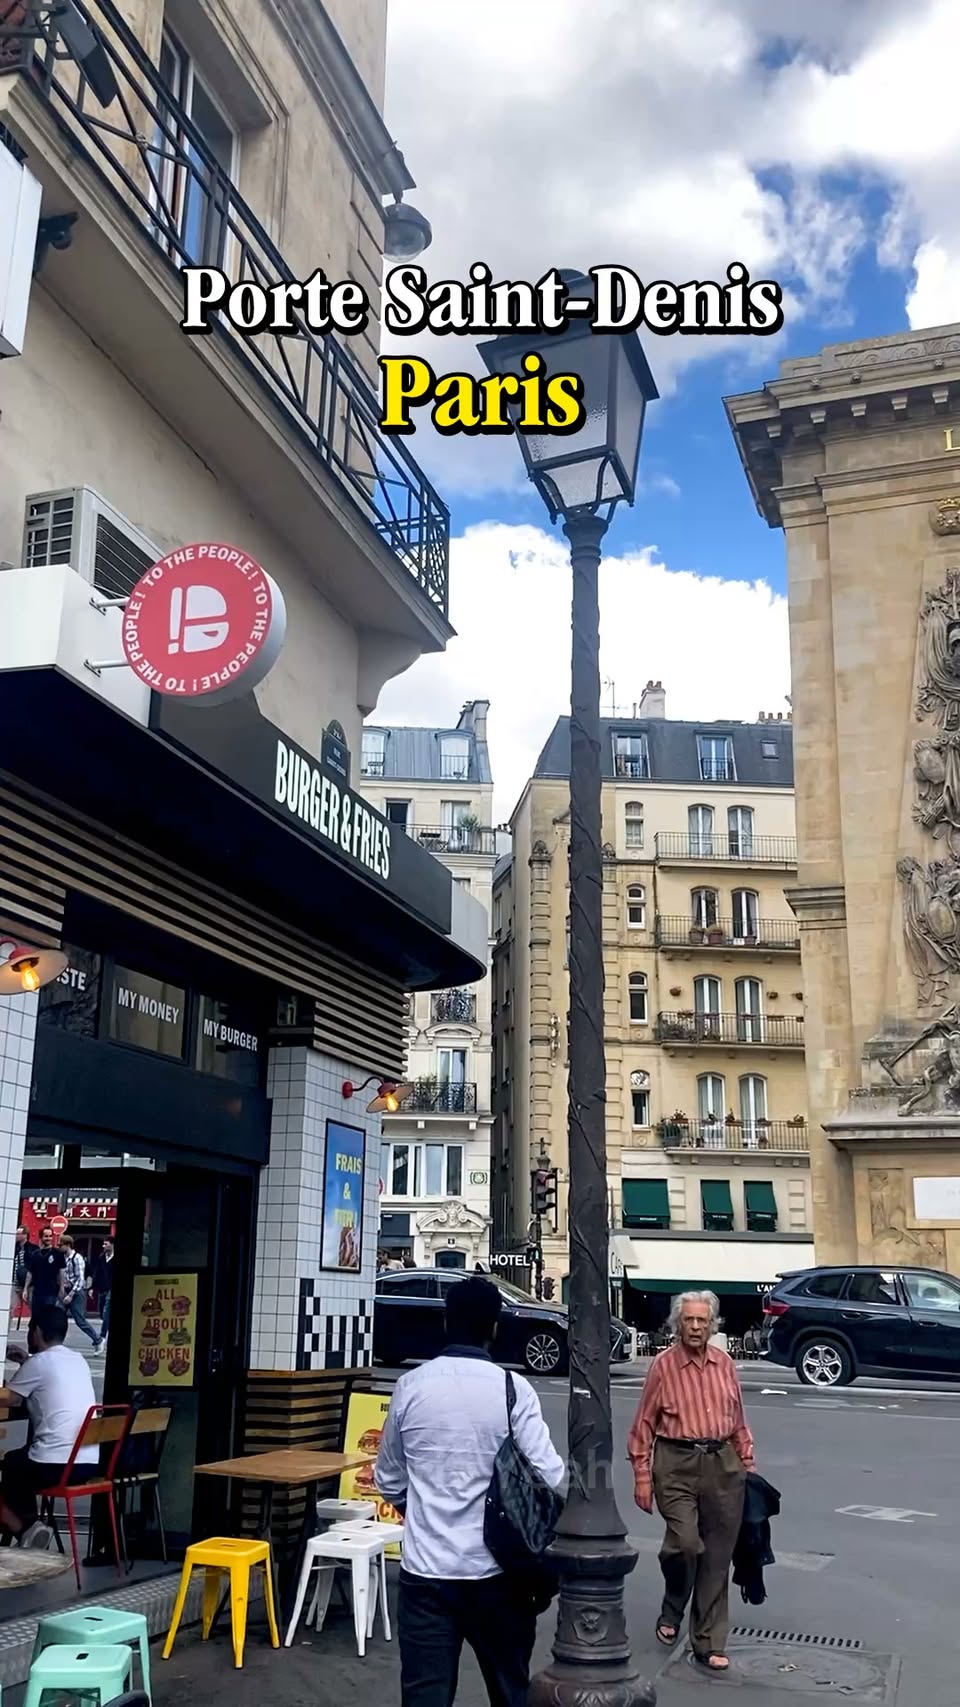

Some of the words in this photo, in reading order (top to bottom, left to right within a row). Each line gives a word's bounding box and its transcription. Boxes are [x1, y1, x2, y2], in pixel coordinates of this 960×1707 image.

[142, 567, 164, 587] TO
[164, 547, 195, 570] THE
[253, 581, 268, 605] TO
[249, 609, 269, 642] THE
[136, 660, 164, 686] THE
[164, 678, 186, 692] TO
[275, 740, 340, 844] BURGER
[340, 794, 351, 853] &
[117, 987, 138, 1009] MY
[138, 994, 180, 1024] MONEY
[203, 1018, 220, 1038] MY
[220, 1024, 258, 1051] BURGER
[335, 1152, 362, 1175] FRAIS
[343, 1182, 351, 1200] &
[489, 1254, 531, 1267] HOTEL
[156, 1288, 176, 1300] ALL
[145, 1318, 186, 1330] ABOUT
[138, 1348, 191, 1360] CHICKEN
